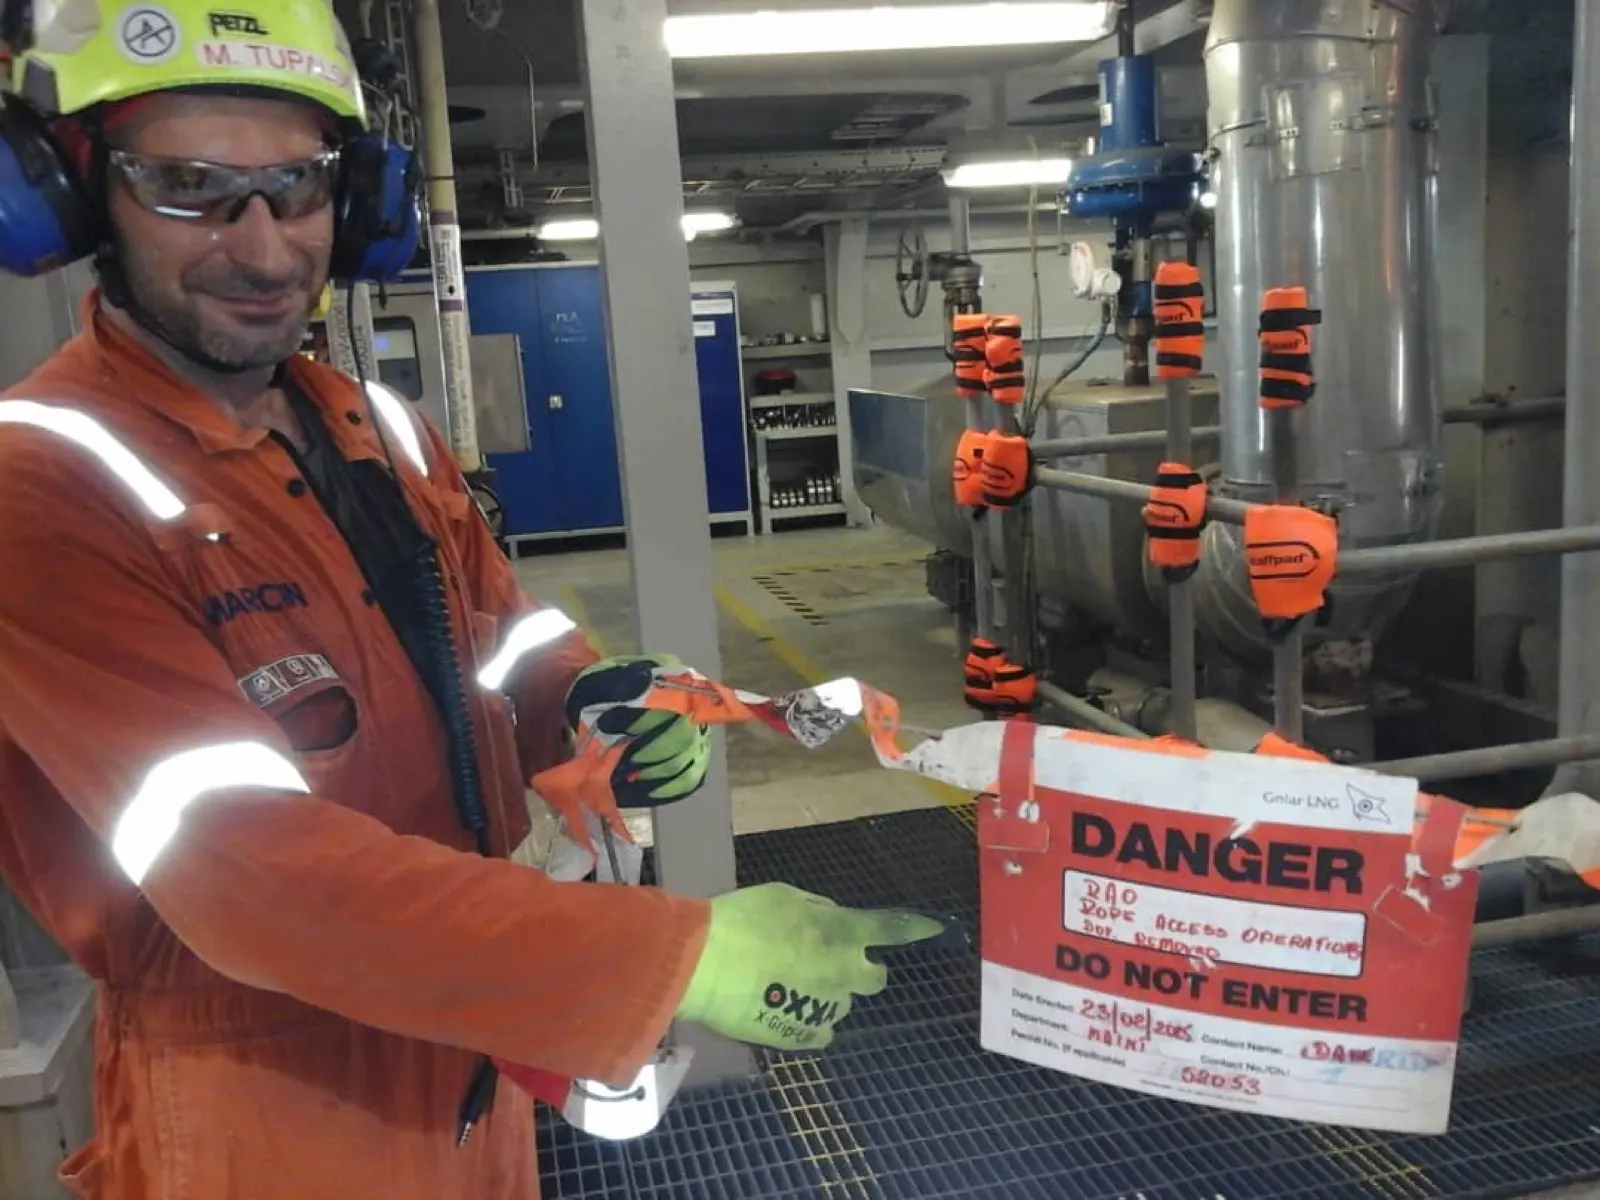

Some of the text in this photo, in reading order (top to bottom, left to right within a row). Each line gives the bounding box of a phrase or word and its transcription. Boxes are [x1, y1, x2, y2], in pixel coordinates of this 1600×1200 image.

[208, 12, 270, 37] PETZL
[1307, 794, 1340, 811] LNG
[1071, 811, 1365, 895] DANGER
[1155, 912, 1228, 938] ACCESS
[1055, 944, 1368, 1021] DO NOT ENTER
[1200, 1033, 1245, 1051] Contact
[1200, 1054, 1245, 1071] Contact
